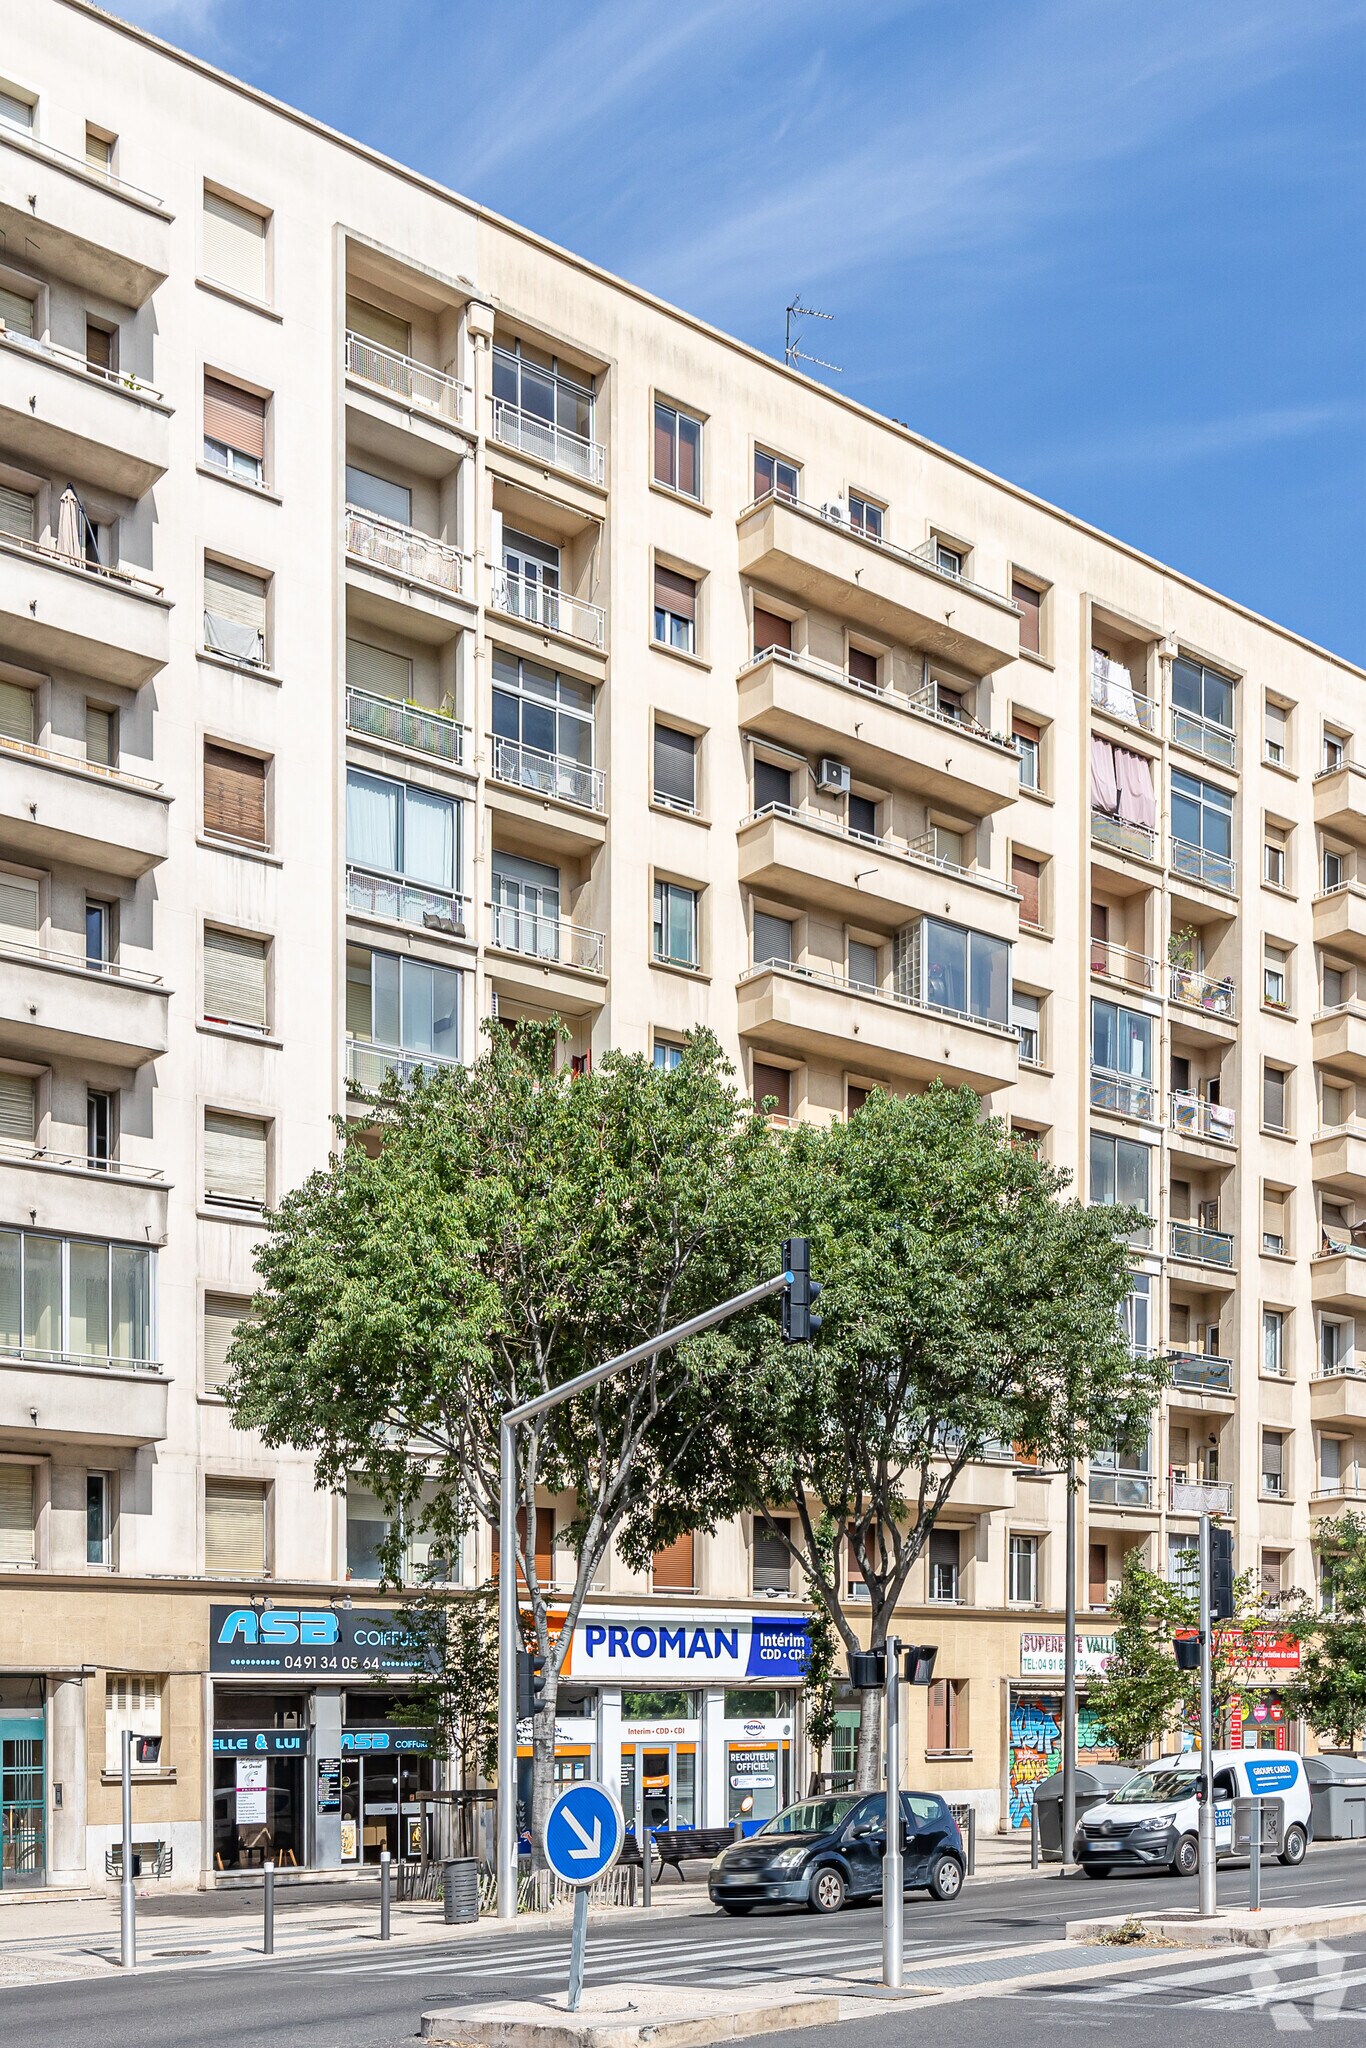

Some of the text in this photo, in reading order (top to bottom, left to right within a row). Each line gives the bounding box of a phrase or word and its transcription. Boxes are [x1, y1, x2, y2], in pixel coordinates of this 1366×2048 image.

[217, 1609, 339, 1645] ASB
[585, 1624, 739, 1659] PROMAN
[760, 1632, 805, 1648] Intérim
[1023, 1635, 1083, 1653] SUPEREE
[760, 1648, 782, 1660] CDD
[320, 1656, 338, 1669] 34
[1048, 1659, 1058, 1670] 91
[628, 1727, 651, 1735] Interim
[655, 1727, 669, 1735] CDD
[212, 1733, 300, 1750] ELLE & LUI
[340, 1733, 390, 1749] ASB
[730, 1752, 775, 1762] RECRUTEUR
[736, 1762, 769, 1771] OFFICIEL
[1253, 1765, 1291, 1776] GROUPE CARSO
